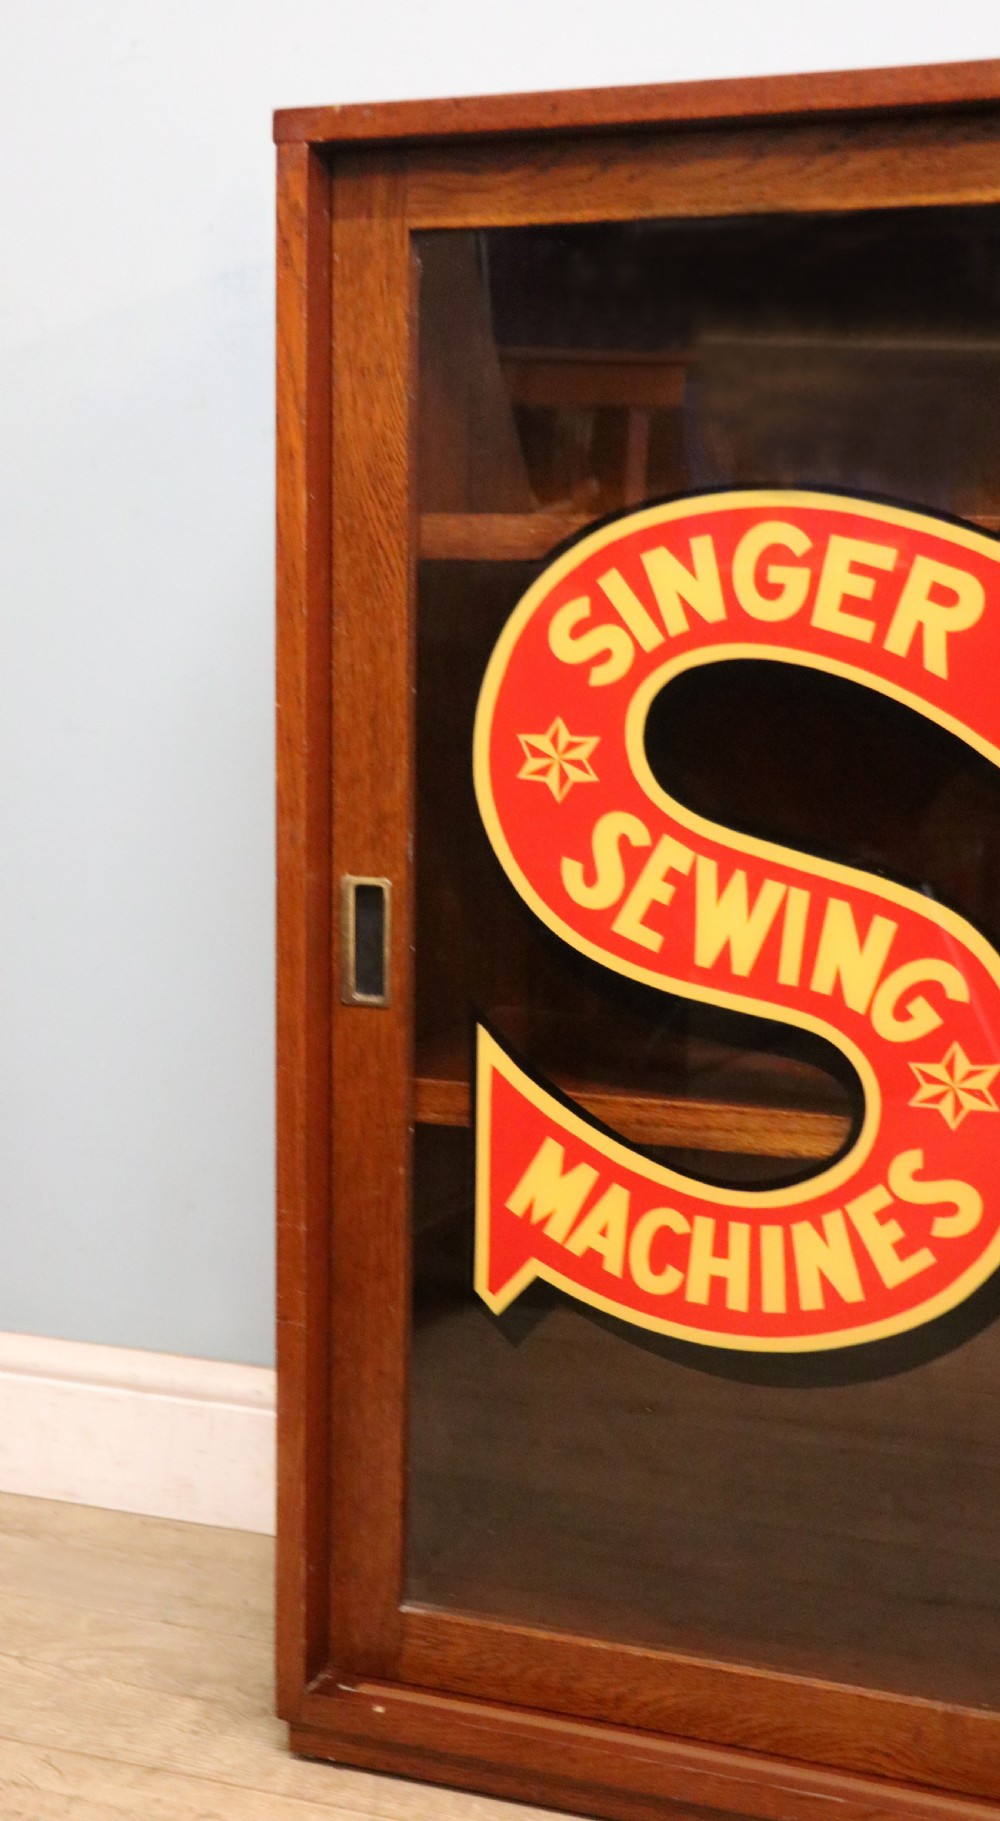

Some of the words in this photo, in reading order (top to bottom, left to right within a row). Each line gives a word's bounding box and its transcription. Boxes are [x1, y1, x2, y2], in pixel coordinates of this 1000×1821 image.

[547, 521, 985, 687] SINGER
[561, 811, 969, 1043] SEWING
[506, 1137, 983, 1313] MACHINES
